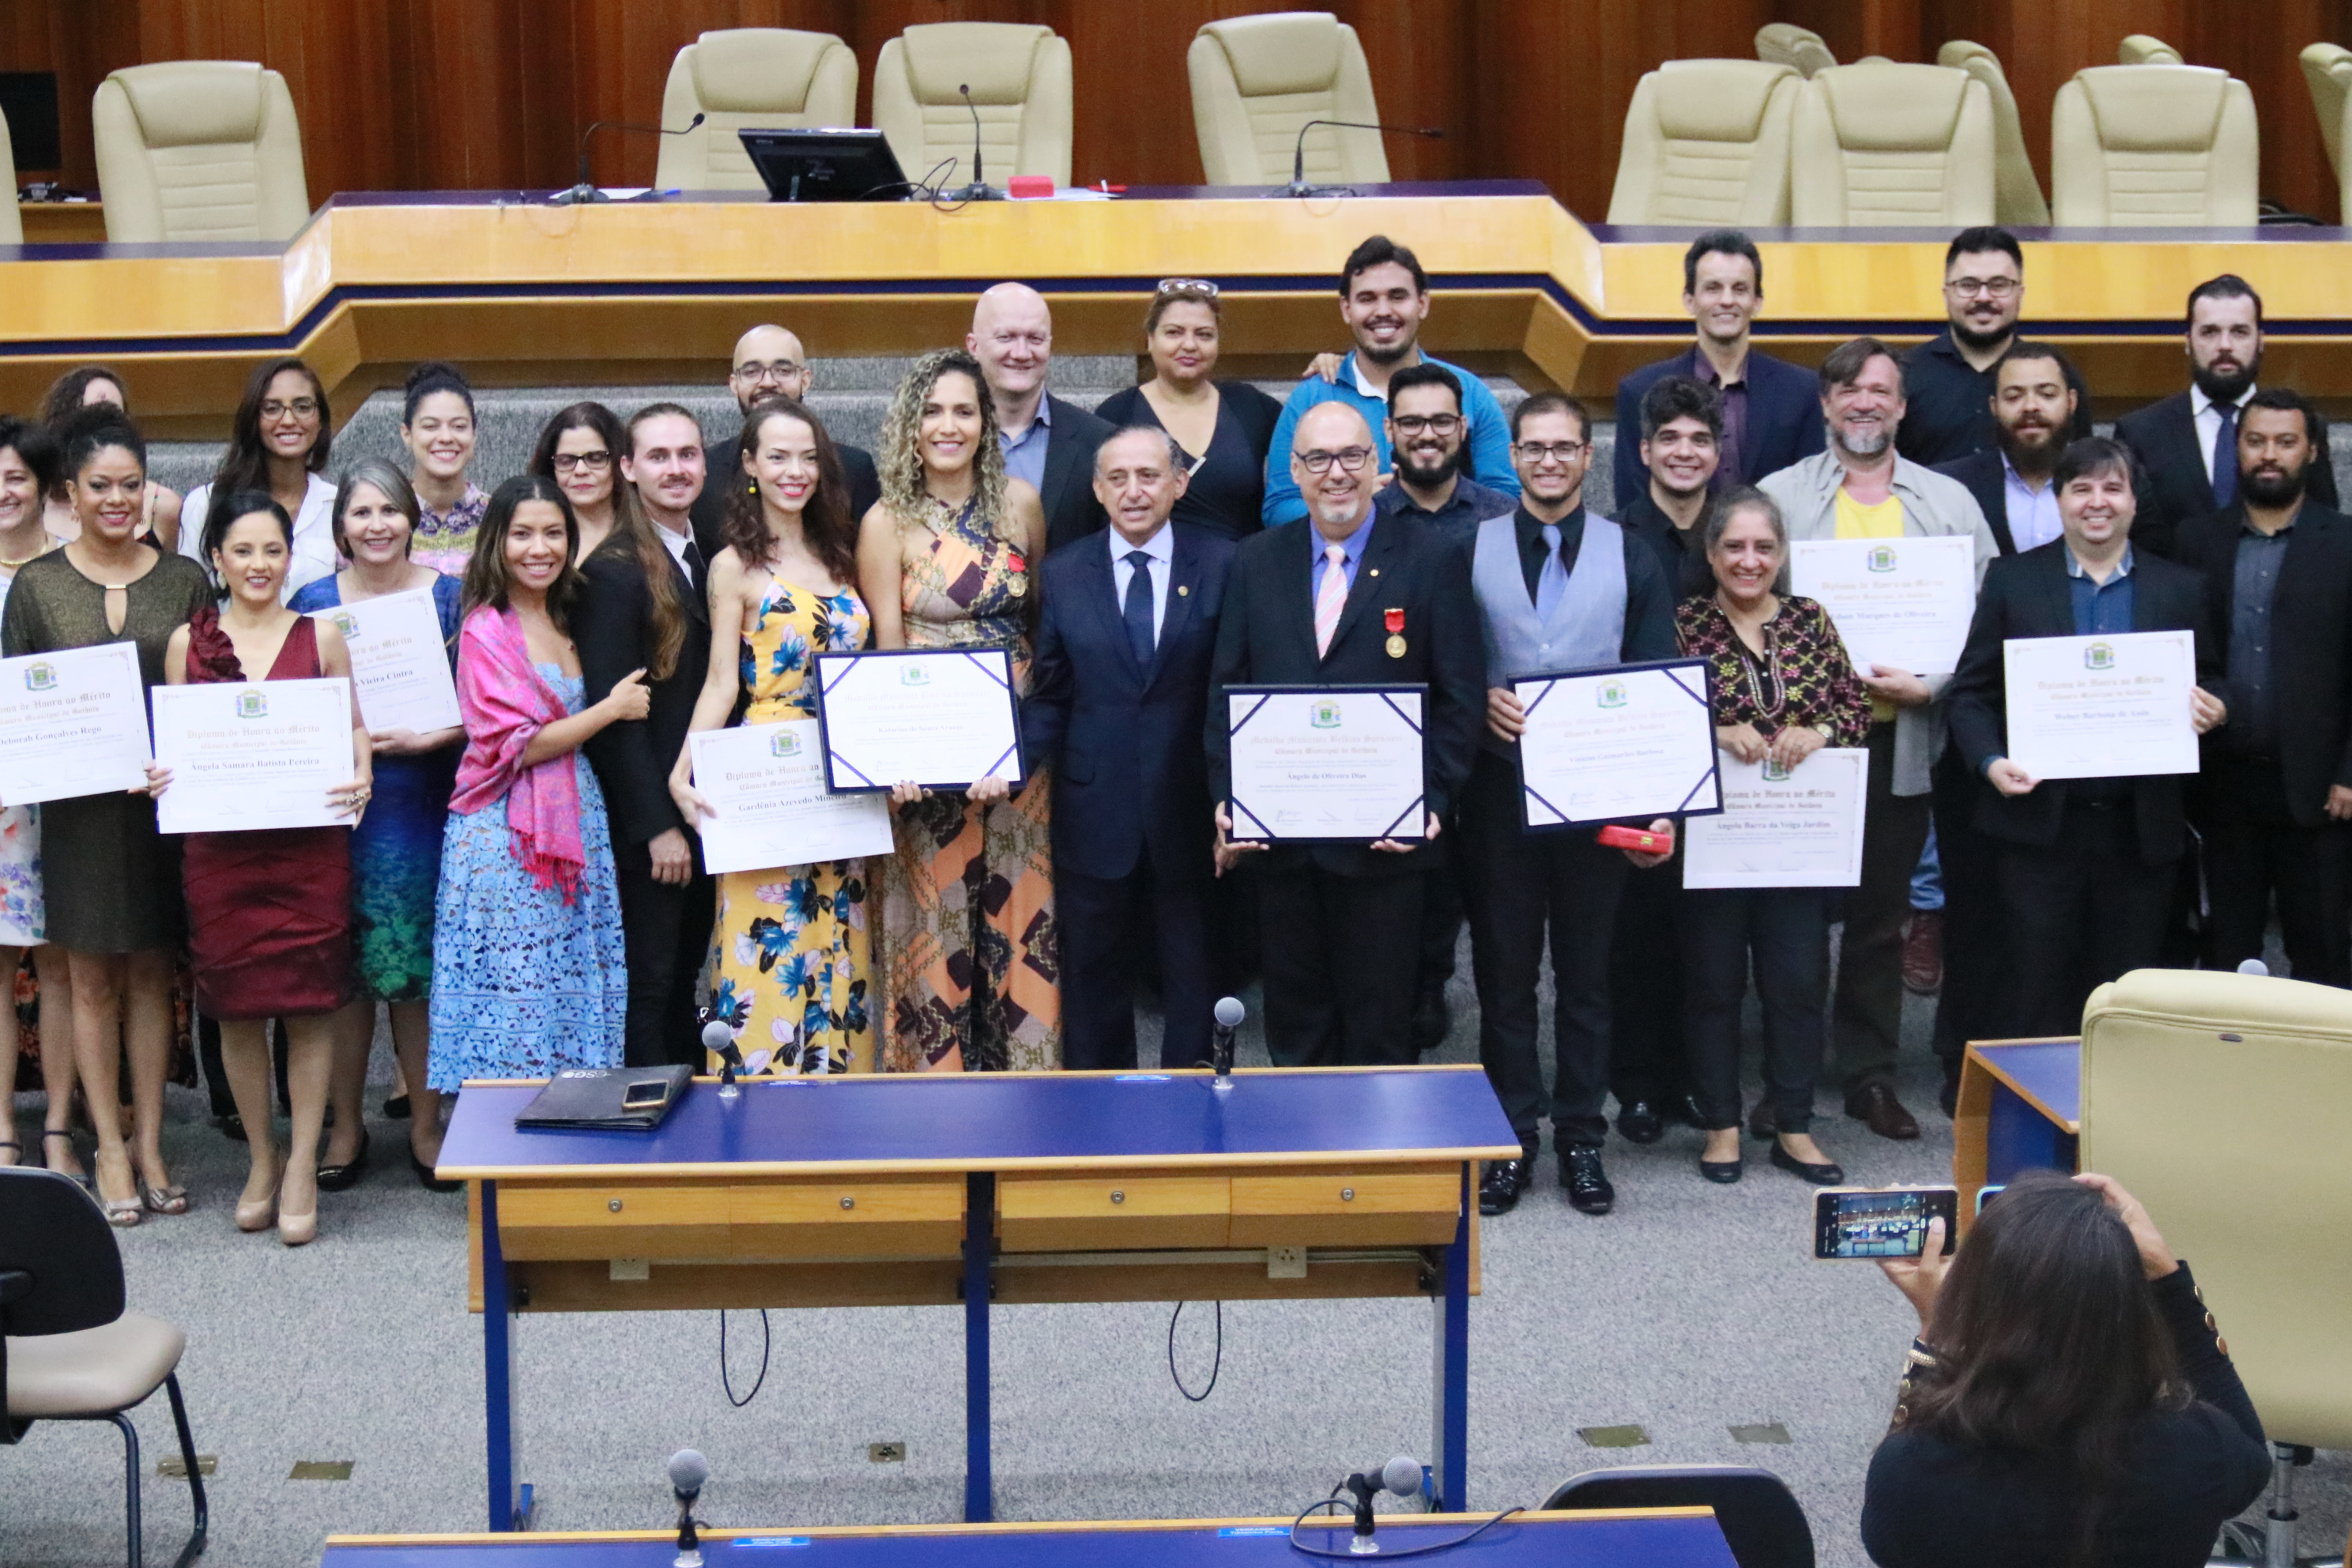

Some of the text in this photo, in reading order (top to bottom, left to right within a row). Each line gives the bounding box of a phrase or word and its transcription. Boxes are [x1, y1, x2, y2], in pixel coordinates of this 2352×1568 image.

[360, 677, 385, 686] Vieira
[386, 670, 413, 680] Cintra
[33, 699, 62, 709] Honra
[80, 692, 111, 703] Mérito
[36, 730, 78, 741] Gonçalves
[187, 729, 225, 740] Diploma
[229, 728, 238, 737] de
[241, 726, 271, 736] Honra
[288, 724, 320, 734] Mérito
[190, 757, 319, 771] Ângela Samara Batista Pereira
[726, 772, 762, 782] Diploma
[766, 767, 775, 776] de
[778, 765, 806, 775] Honra
[739, 801, 776, 811] Gardênia
[780, 797, 812, 806] Azevedo
